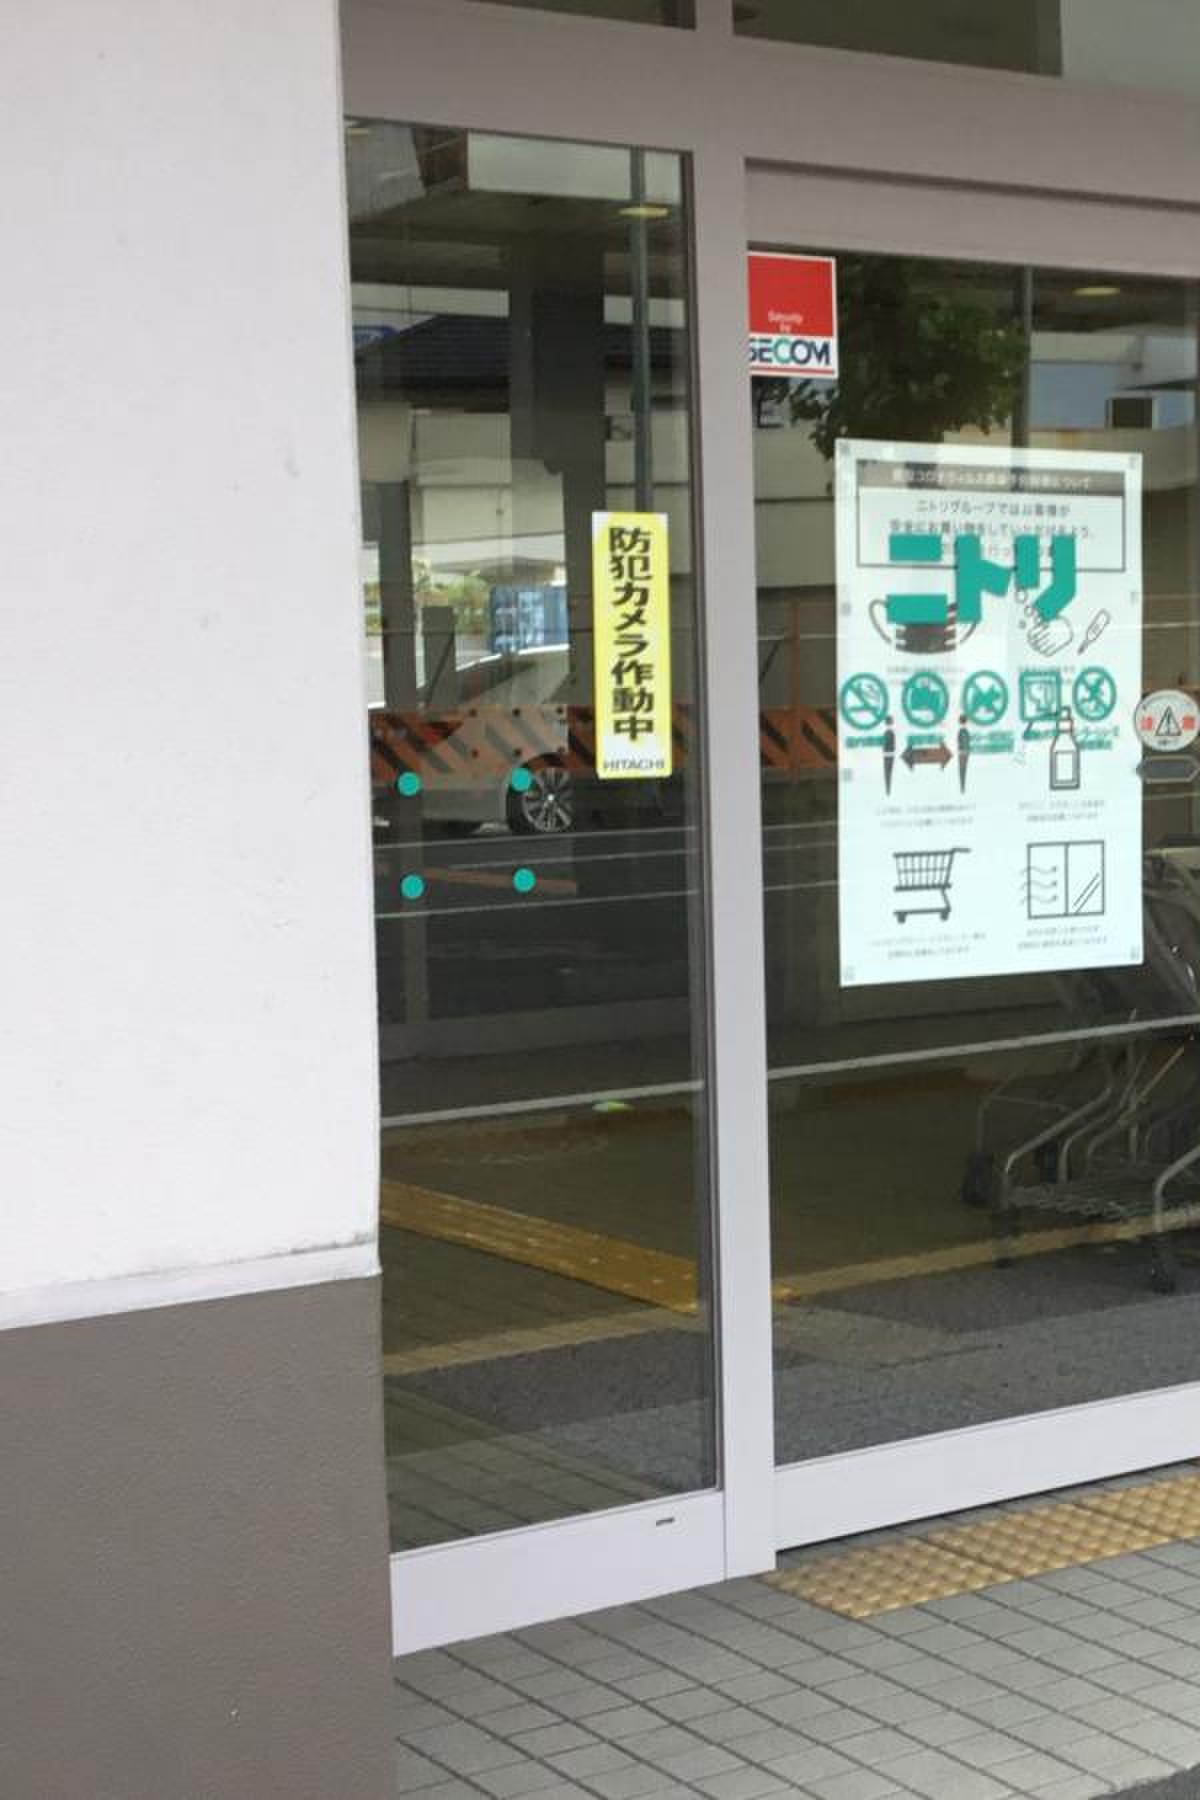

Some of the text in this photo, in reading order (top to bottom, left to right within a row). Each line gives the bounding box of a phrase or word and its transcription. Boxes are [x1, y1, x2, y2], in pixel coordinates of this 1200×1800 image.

[886, 534, 1076, 622] ニトリ
[608, 526, 655, 742] 防犯カメラ作動中
[603, 758, 665, 771] HITACHI
